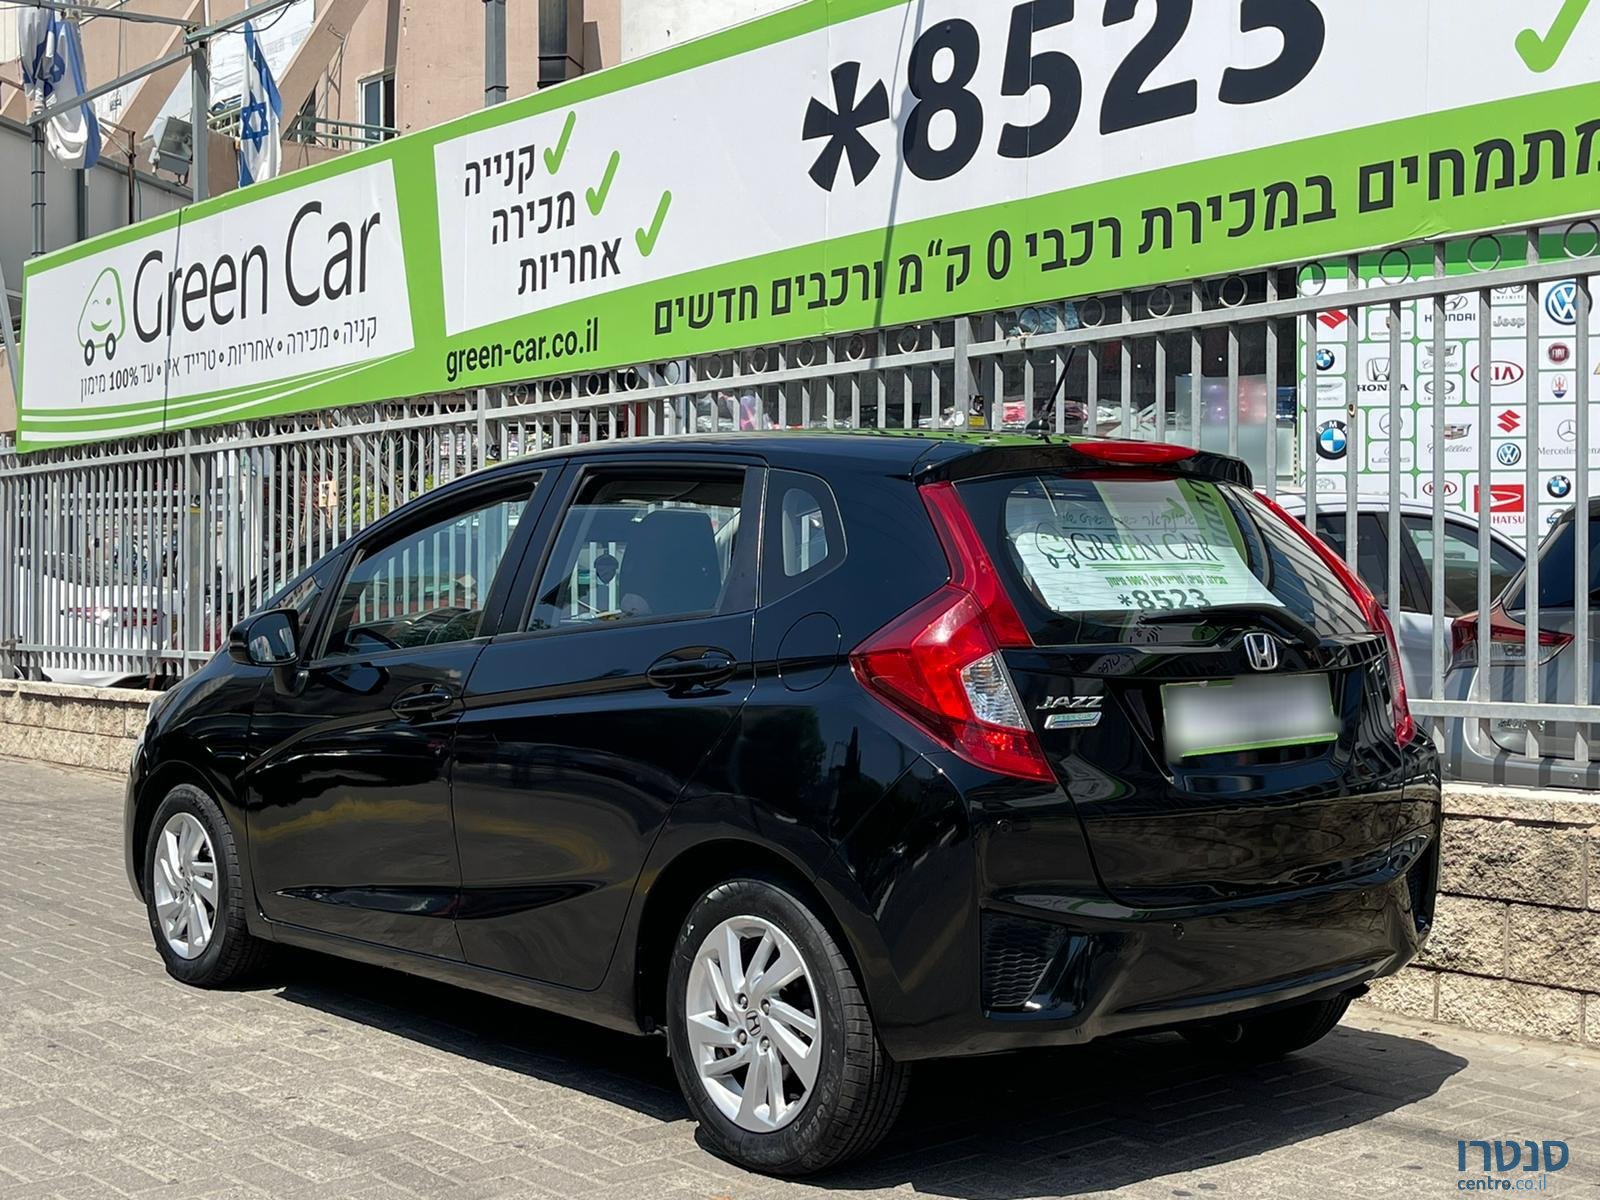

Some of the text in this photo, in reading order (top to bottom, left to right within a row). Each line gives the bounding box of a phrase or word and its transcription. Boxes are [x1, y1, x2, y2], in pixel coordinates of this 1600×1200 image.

[465, 144, 535, 197] קנייה
[492, 191, 576, 245] מכירה
[1138, 174, 1337, 255] במכירת
[987, 230, 1012, 280] 0
[1025, 216, 1122, 273] רכבי
[133, 200, 381, 342] Green Car
[518, 238, 622, 296] אחריות
[771, 260, 884, 317] ורכבים
[655, 284, 758, 336] חדשים
[287, 326, 330, 355] מכירה
[343, 316, 378, 347] קניה
[446, 317, 599, 383] green-car.co.il
[184, 349, 216, 375] טרייד
[227, 337, 275, 367] אחריות
[80, 374, 106, 403] מימון
[109, 365, 139, 391] 100%
[141, 363, 155, 384] עד
[1356, 383, 1410, 392] HONA
[1070, 532, 1221, 562] GREEN CAR
[1035, 695, 1105, 710] JAZZ
